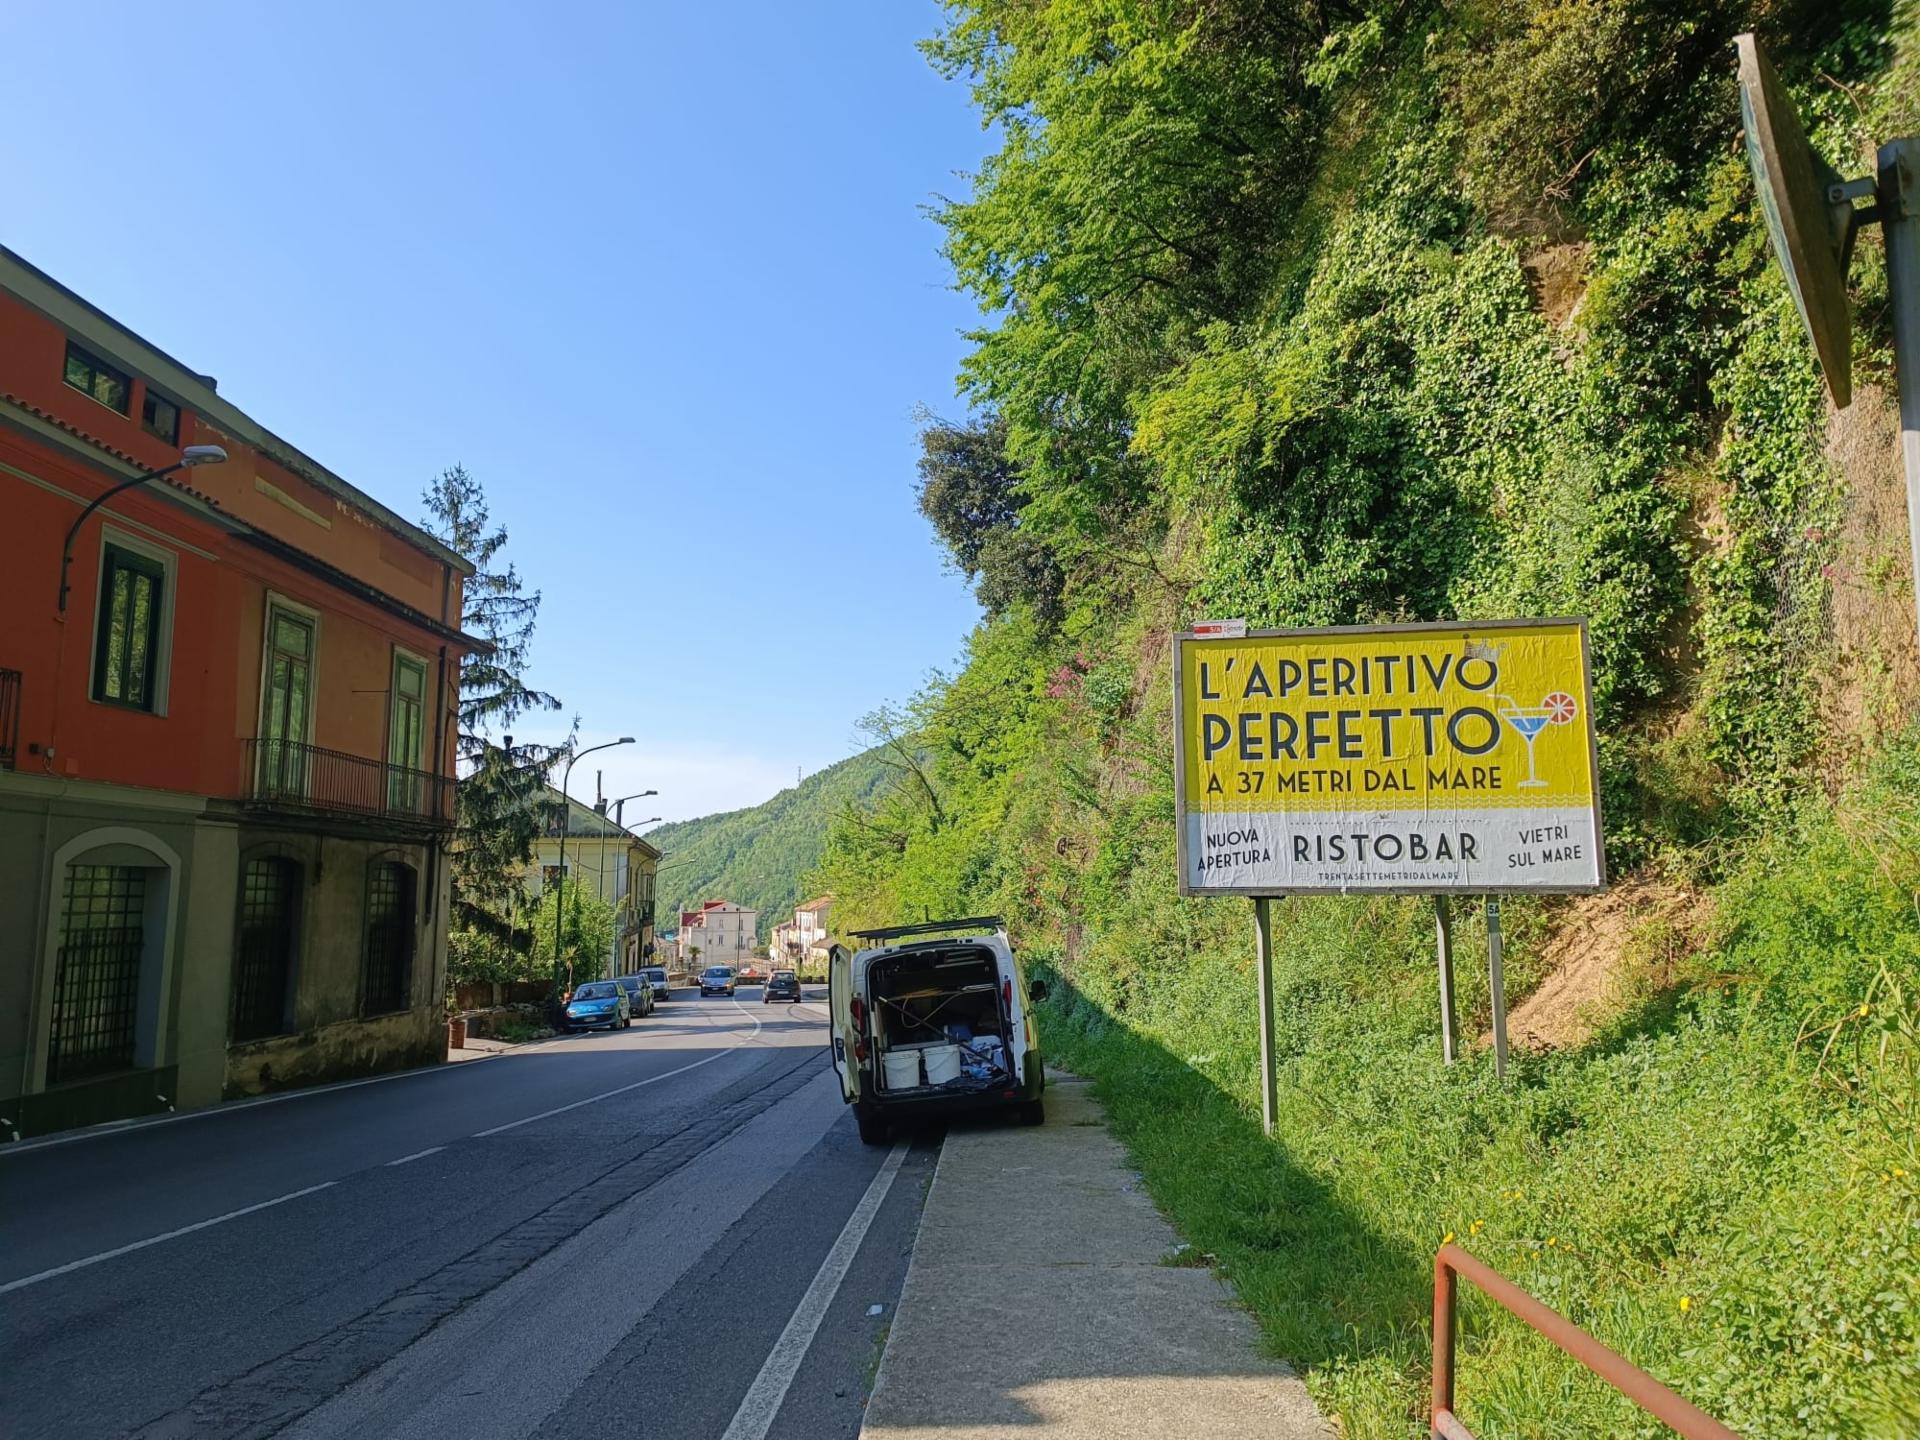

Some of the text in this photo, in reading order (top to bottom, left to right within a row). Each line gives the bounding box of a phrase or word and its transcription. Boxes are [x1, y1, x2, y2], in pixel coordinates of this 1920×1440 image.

[1200, 654, 1498, 699] L'APERITIVO
[1202, 706, 1501, 761] PERFETTO
[1206, 766, 1502, 794] A 37 METRI DAL MARE
[1206, 829, 1259, 849] NUOVA
[1518, 825, 1568, 845] VIETRI
[1293, 833, 1479, 862] RISTOBAR
[1507, 845, 1582, 868] SUL MARE
[1197, 848, 1271, 872] APERTURA
[1318, 871, 1460, 881] TRENTASETTEMETRIDALMARE
